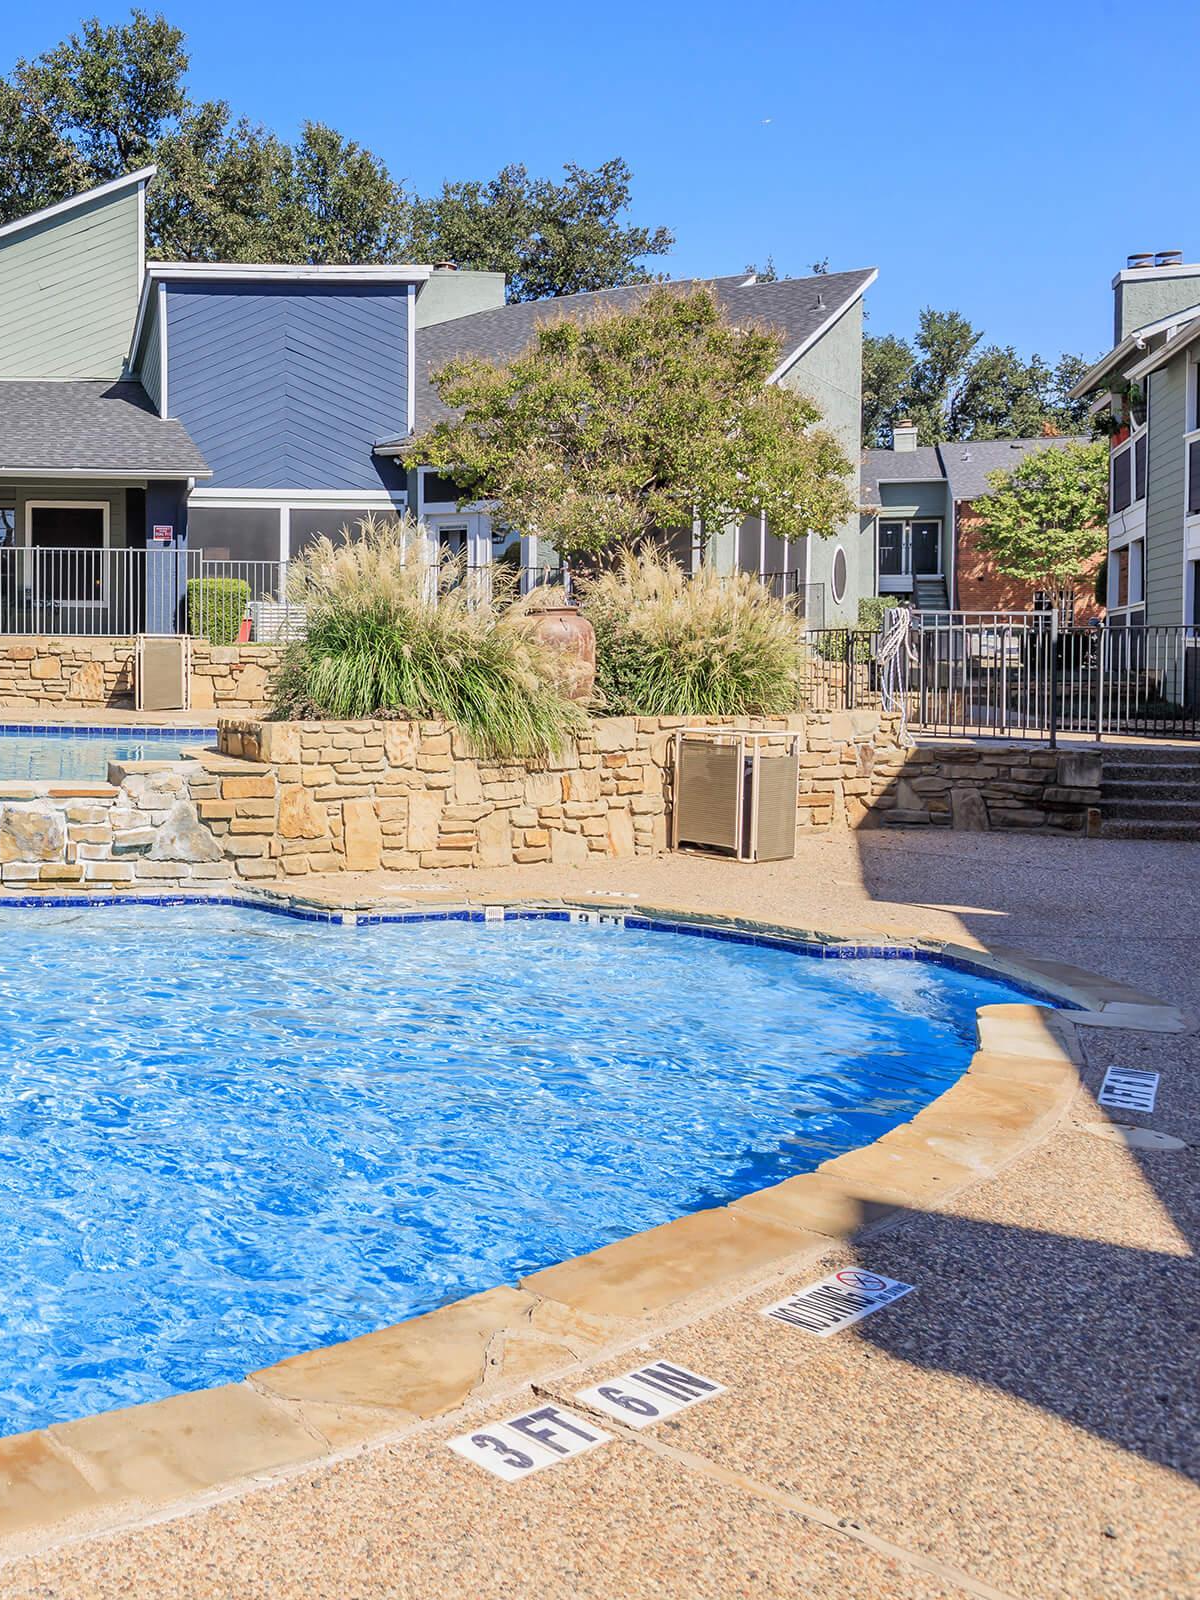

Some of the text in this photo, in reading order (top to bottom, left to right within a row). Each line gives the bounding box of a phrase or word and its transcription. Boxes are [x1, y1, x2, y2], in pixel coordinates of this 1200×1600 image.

[768, 1285, 875, 1334] NO DIVING
[471, 1362, 718, 1469] 3 FT 6 IN
